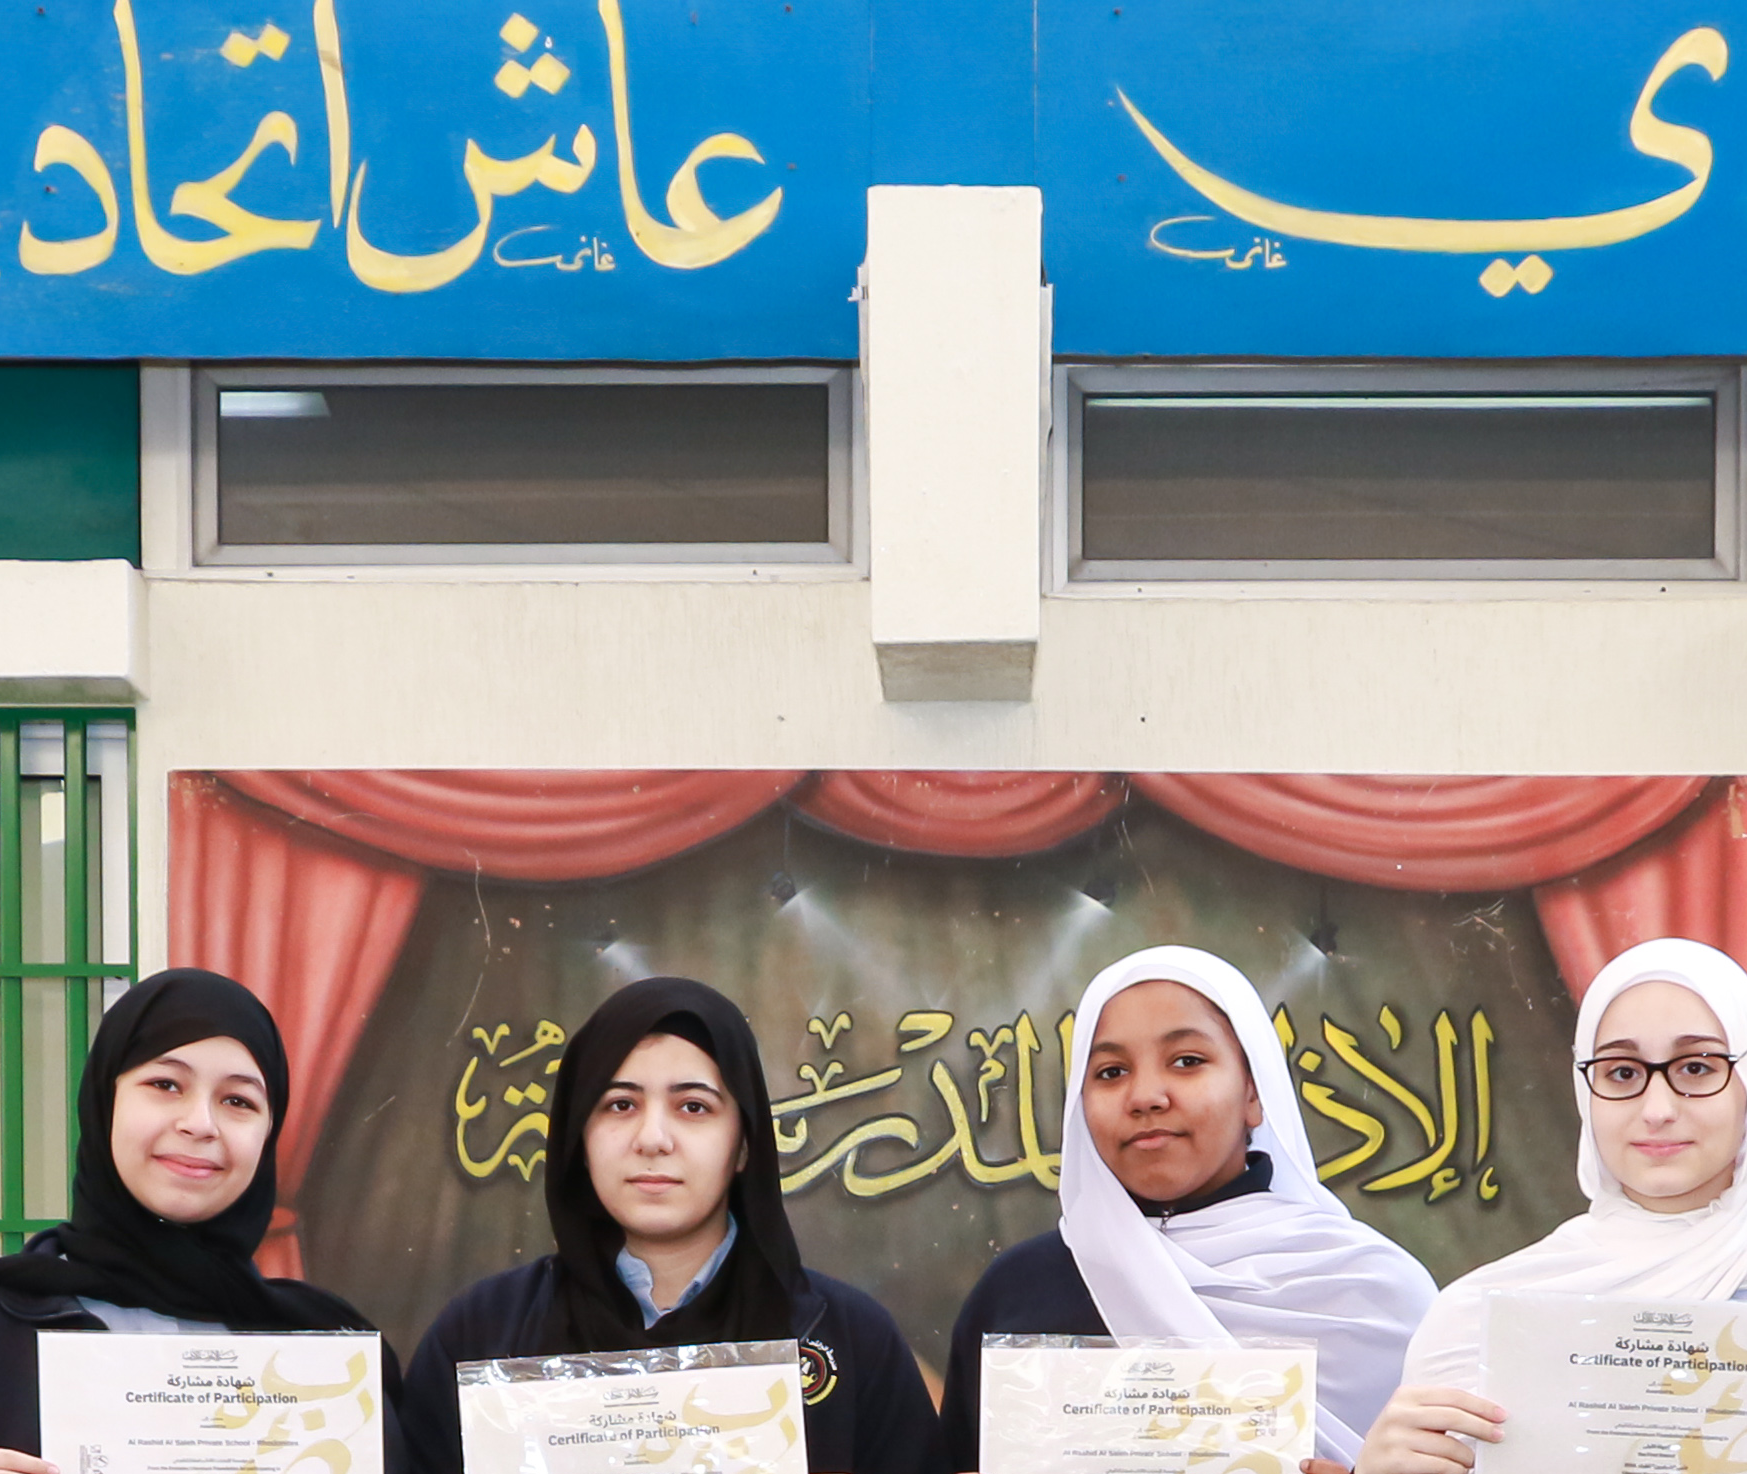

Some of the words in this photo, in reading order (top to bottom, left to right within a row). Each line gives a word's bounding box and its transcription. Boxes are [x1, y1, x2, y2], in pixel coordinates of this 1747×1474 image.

[18, 0, 351, 275] اتحاد
[345, 0, 784, 293] عاش
[1615, 1336, 1664, 1353] مشاركة
[1667, 1339, 1710, 1356] شهادة
[1569, 1353, 1643, 1368] Ctificate
[1646, 1356, 1661, 1368] of
[166, 1374, 213, 1390] مشاركة
[217, 1375, 255, 1391] شهادة
[125, 1391, 195, 1404] Certificate
[198, 1391, 211, 1404] of
[213, 1392, 299, 1406] Participation
[1104, 1387, 1148, 1401] مشاركة
[1152, 1388, 1191, 1401] شهادة
[638, 1410, 677, 1425] شهادة
[1063, 1403, 1130, 1416] Certificate
[1132, 1403, 1146, 1416] of
[1148, 1404, 1232, 1418] Participation
[589, 1414, 634, 1428] مشاركة
